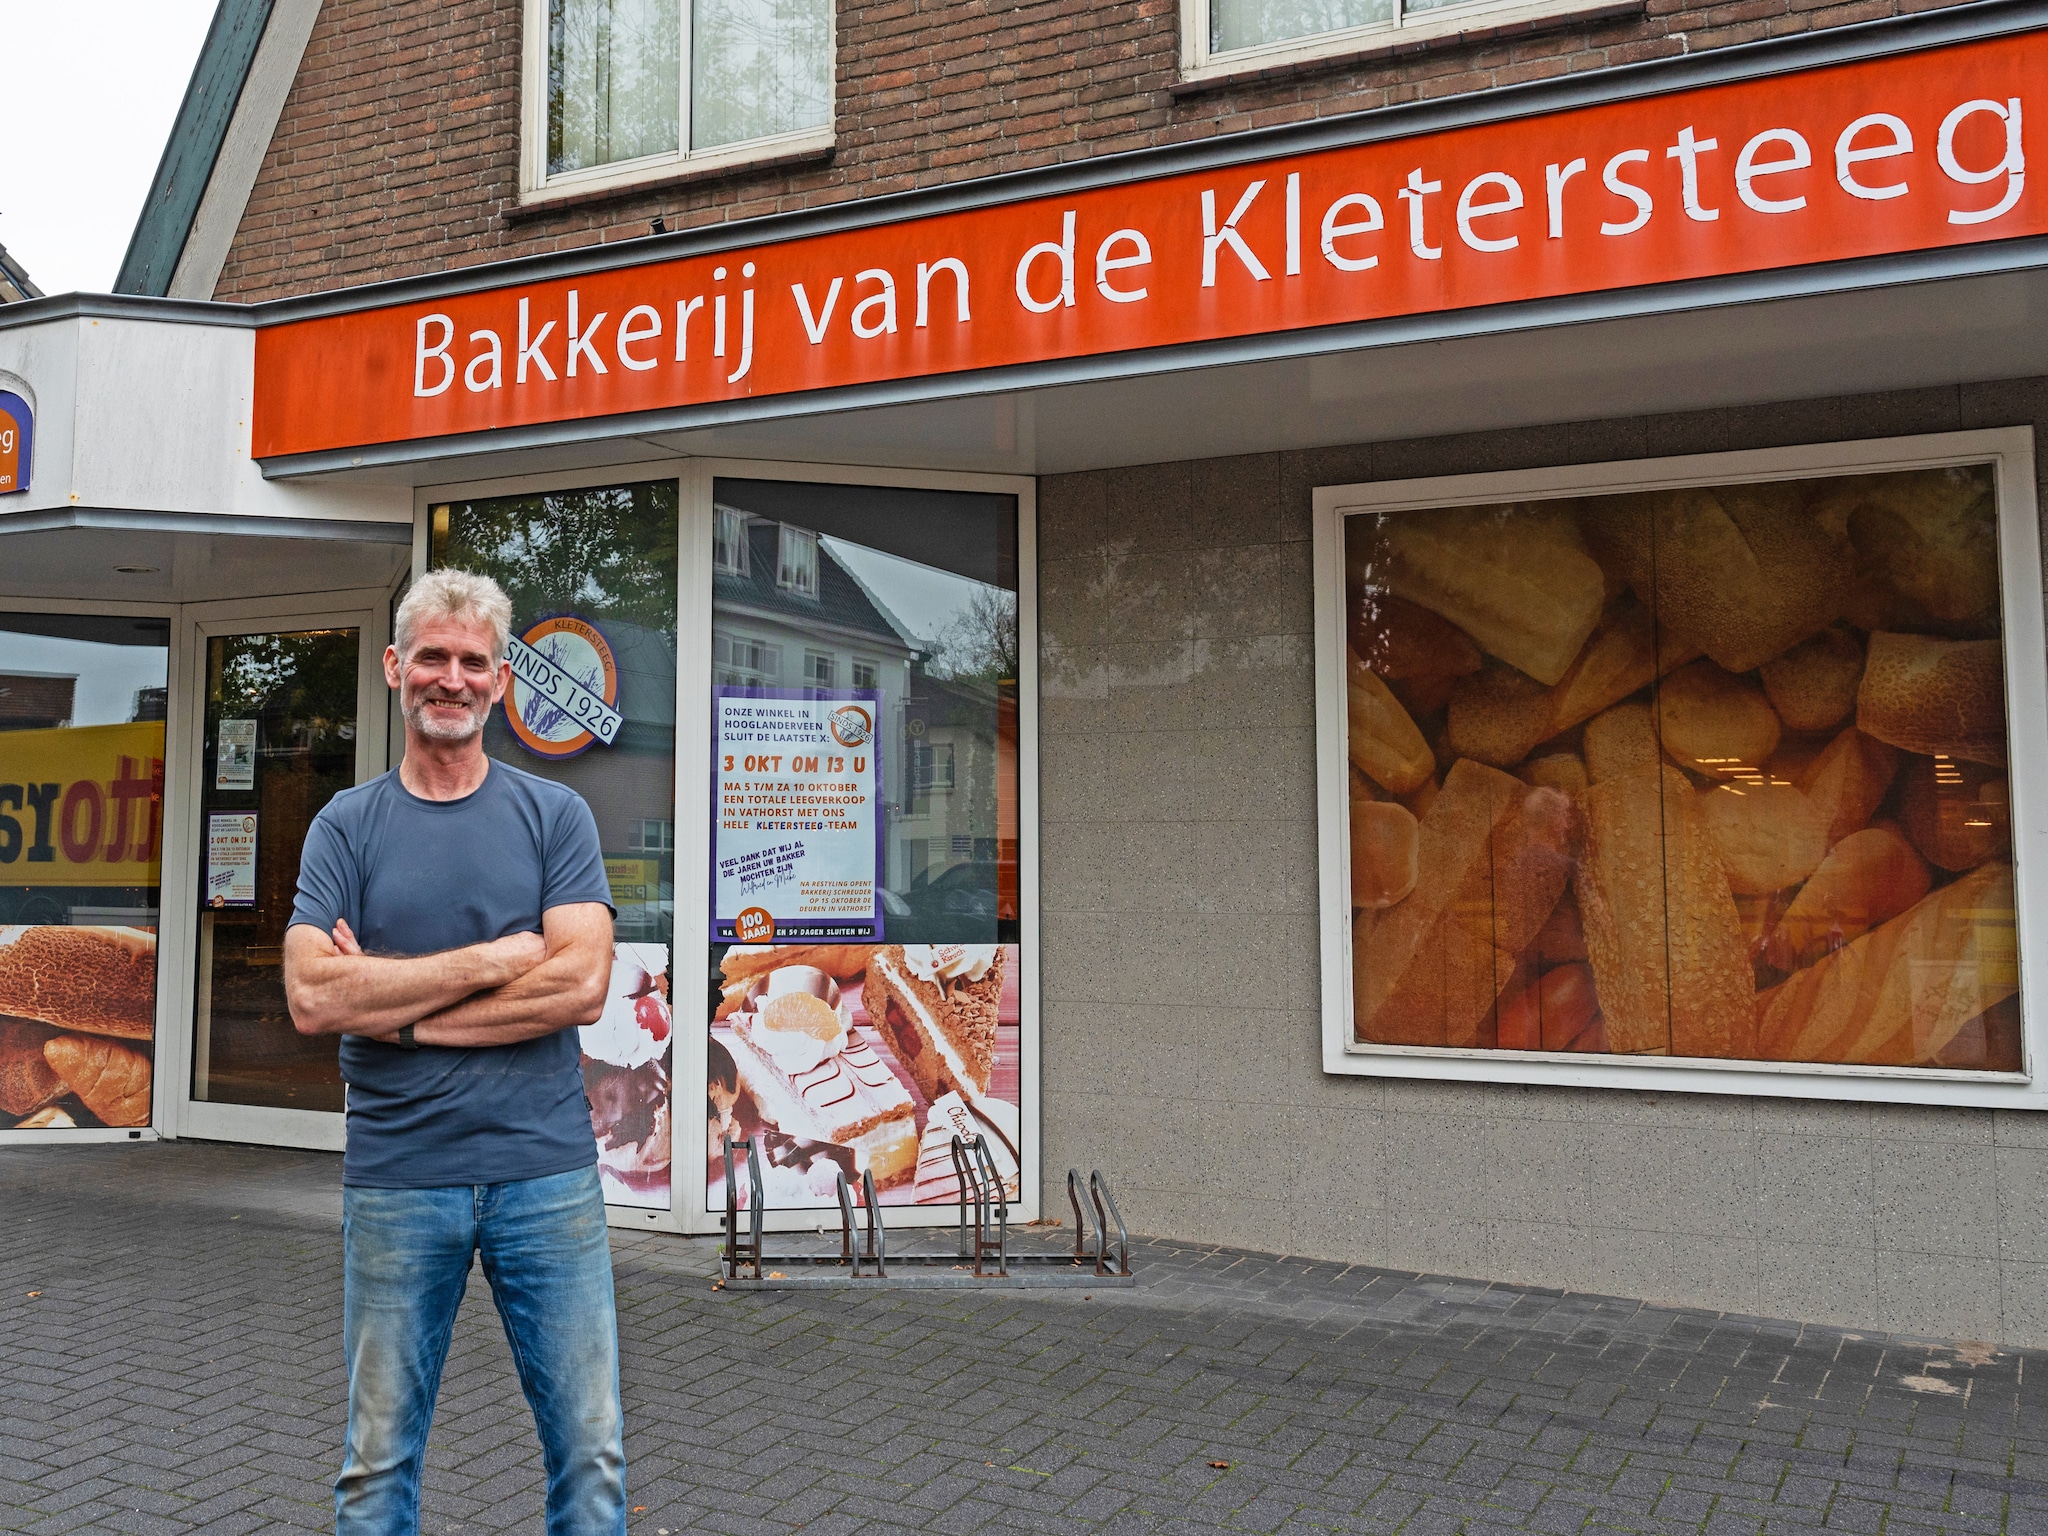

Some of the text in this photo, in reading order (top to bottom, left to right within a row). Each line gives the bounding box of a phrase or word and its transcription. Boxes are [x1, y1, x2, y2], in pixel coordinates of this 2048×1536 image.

[412, 96, 2026, 399] Bakkerij van de Kletersteeg
[0, 429, 14, 454] g
[554, 620, 613, 672] KLETERSTEEG
[503, 641, 617, 737] SINDS 1926
[725, 707, 809, 718] ONZE WINKEL IN
[724, 720, 823, 731] HOOGLANDERVEEN
[829, 713, 871, 741] SINDS 1926
[724, 732, 830, 743] SLUIT DE LAATSTE X:
[723, 755, 866, 773] 3 OKT OM 13 U
[724, 782, 857, 792] MA 5 T/M ZA 10 OKTOBER
[724, 795, 866, 805] EEN TOTALE LEEGVERKOOP
[723, 808, 845, 817] IN VATHORST MET ONS
[723, 820, 749, 829] HELE
[719, 840, 804, 869] VEEL DANK DAT WIJ AL
[722, 849, 806, 878] DIE JAREN UW BAKKER
[740, 862, 793, 883] MOCHTEN ZIJN
[740, 911, 763, 929] 100
[776, 928, 787, 936] EN
[800, 928, 824, 936] DAGEN
[826, 928, 855, 936] SLUITEN
[941, 948, 966, 963] Kirsch
[947, 1106, 979, 1143] Chipola
